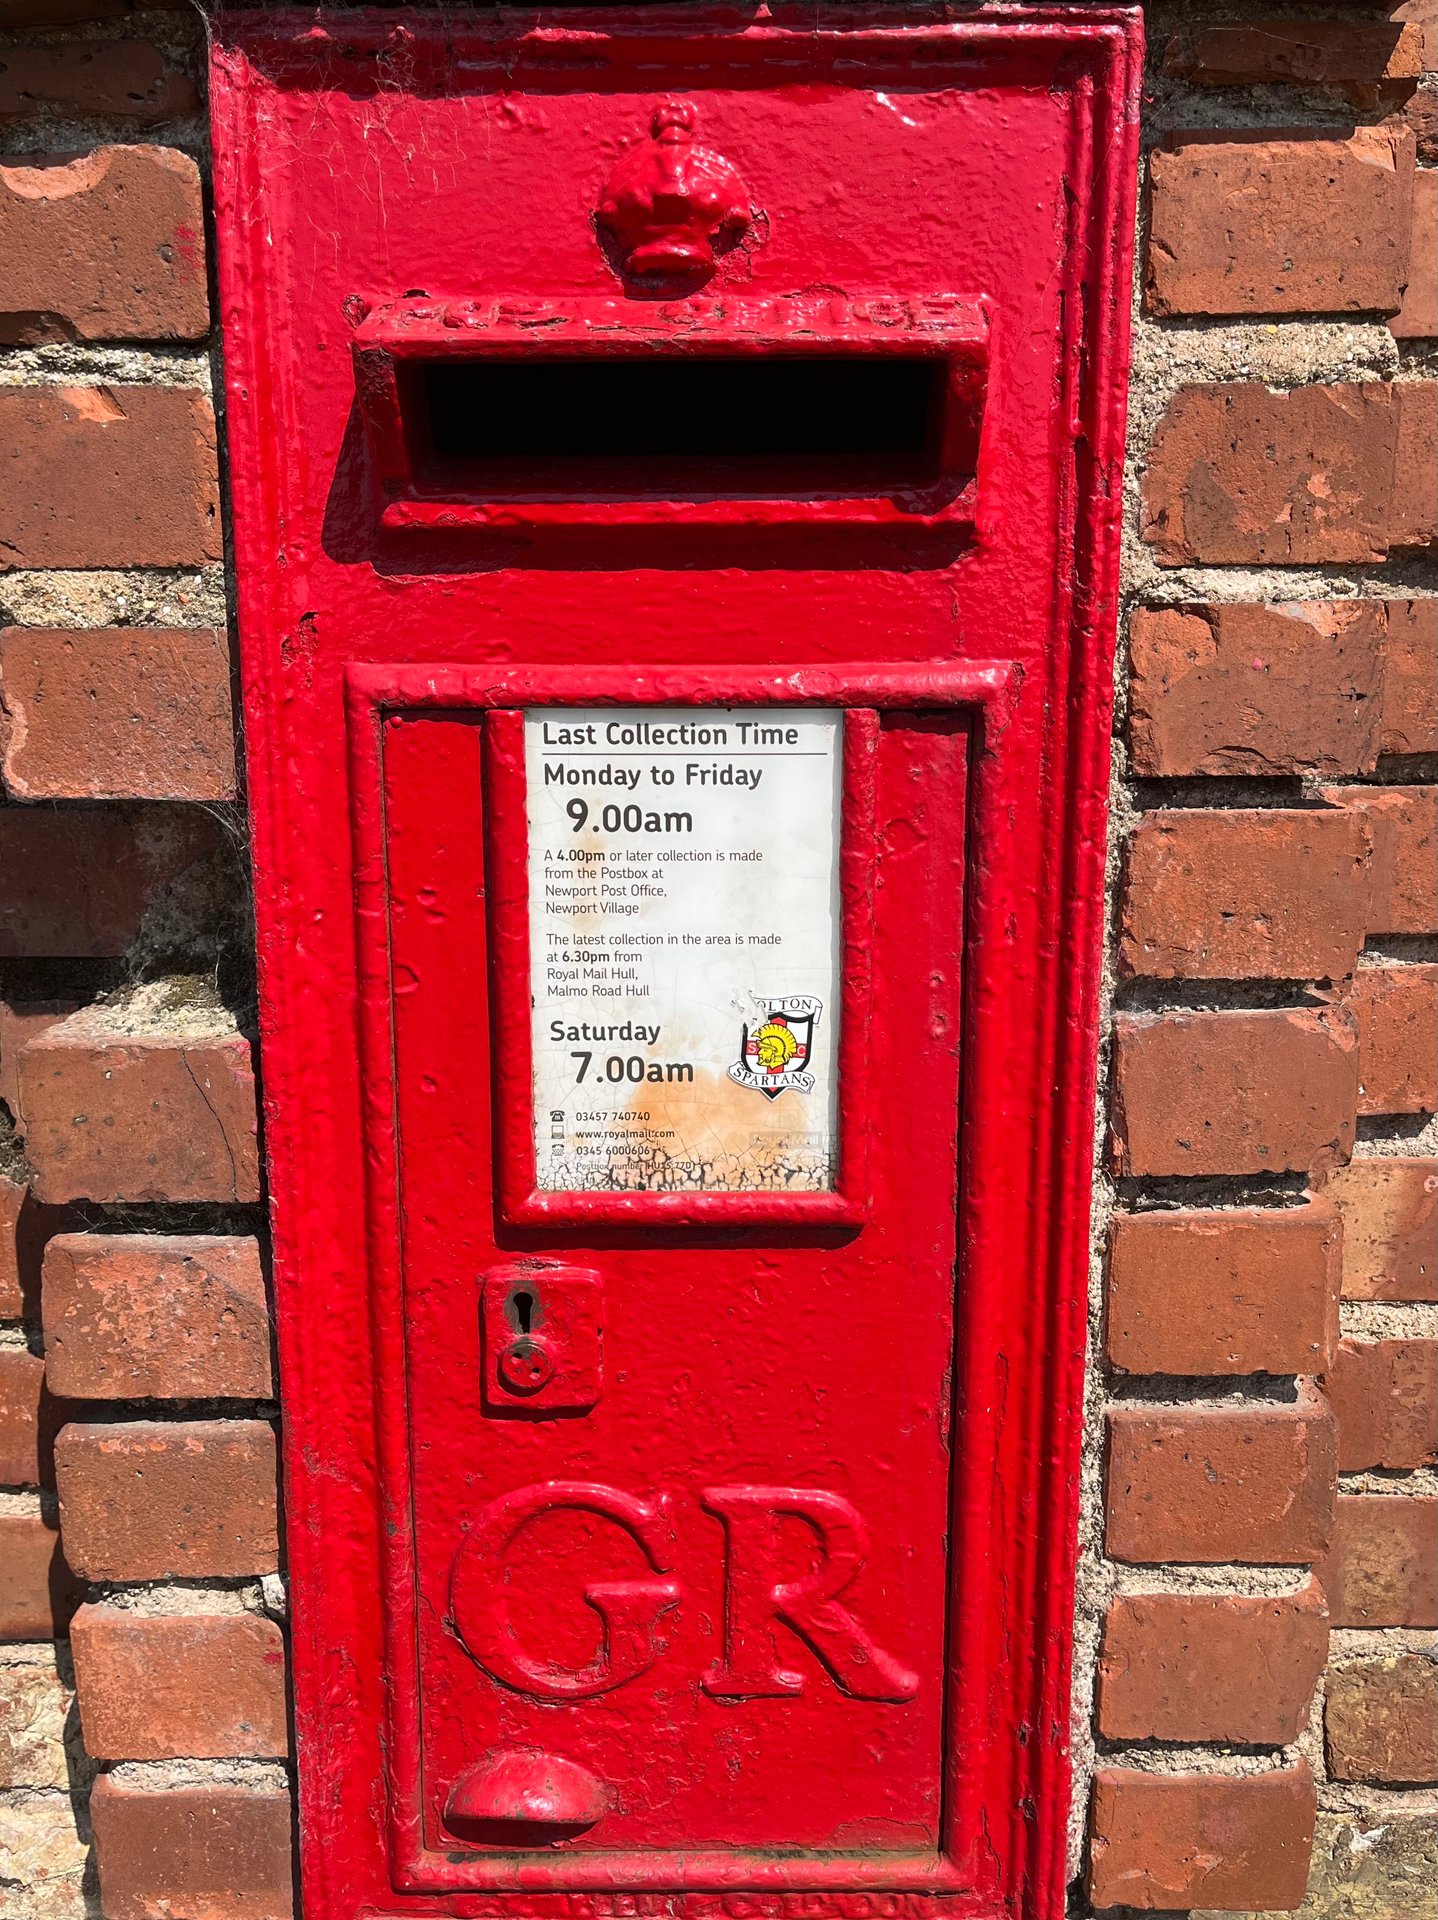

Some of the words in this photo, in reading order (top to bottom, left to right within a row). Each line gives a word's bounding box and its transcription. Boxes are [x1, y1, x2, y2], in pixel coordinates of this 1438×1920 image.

[542, 722, 597, 745] Last
[605, 722, 728, 745] Collection
[736, 722, 799, 745] Time
[544, 763, 641, 790] Monday
[650, 765, 675, 785] to
[685, 763, 762, 790] Friday
[566, 798, 693, 833] 9.00am
[544, 850, 553, 861] A
[557, 850, 605, 864] 4.00pm
[609, 852, 623, 861] or
[626, 850, 653, 861] later
[657, 850, 712, 861] collection
[716, 850, 725, 861] is
[729, 850, 763, 861] made
[545, 867, 573, 879] from
[577, 867, 597, 879] the
[601, 867, 648, 879] Postbox
[652, 868, 663, 879] at
[546, 885, 597, 899] Newport
[601, 885, 627, 896] Post
[631, 884, 667, 898] Office,
[546, 902, 598, 916] Newport
[600, 902, 639, 917] Village
[546, 934, 569, 945] The
[573, 934, 605, 945] latest
[609, 934, 663, 945] collection
[667, 933, 678, 945] in
[682, 933, 701, 945] the
[705, 936, 732, 945] area
[735, 933, 745, 945] is
[748, 933, 782, 945] made
[547, 952, 558, 962] at
[562, 950, 610, 965] 6.30pm
[614, 950, 643, 962] from
[547, 968, 579, 982] Royal
[583, 968, 607, 980] Mail
[611, 968, 638, 981] Hull,
[548, 984, 588, 996] Malmo
[592, 984, 621, 996] Road
[625, 984, 650, 996] Hull
[550, 1020, 661, 1045] Saturday
[748, 1042, 757, 1053] S
[797, 1045, 806, 1057] C
[570, 1051, 694, 1084] 7.00am
[733, 1067, 811, 1087] SPARTANS
[576, 1112, 608, 1121] 03457
[611, 1112, 650, 1121] 740740
[576, 1129, 675, 1140] www.royalmail.com
[576, 1146, 601, 1155] 0345
[606, 1146, 650, 1155] 6000606
[576, 1162, 608, 1171] Postbox
[612, 1162, 643, 1171] number
[448, 1478, 919, 1705] GR
